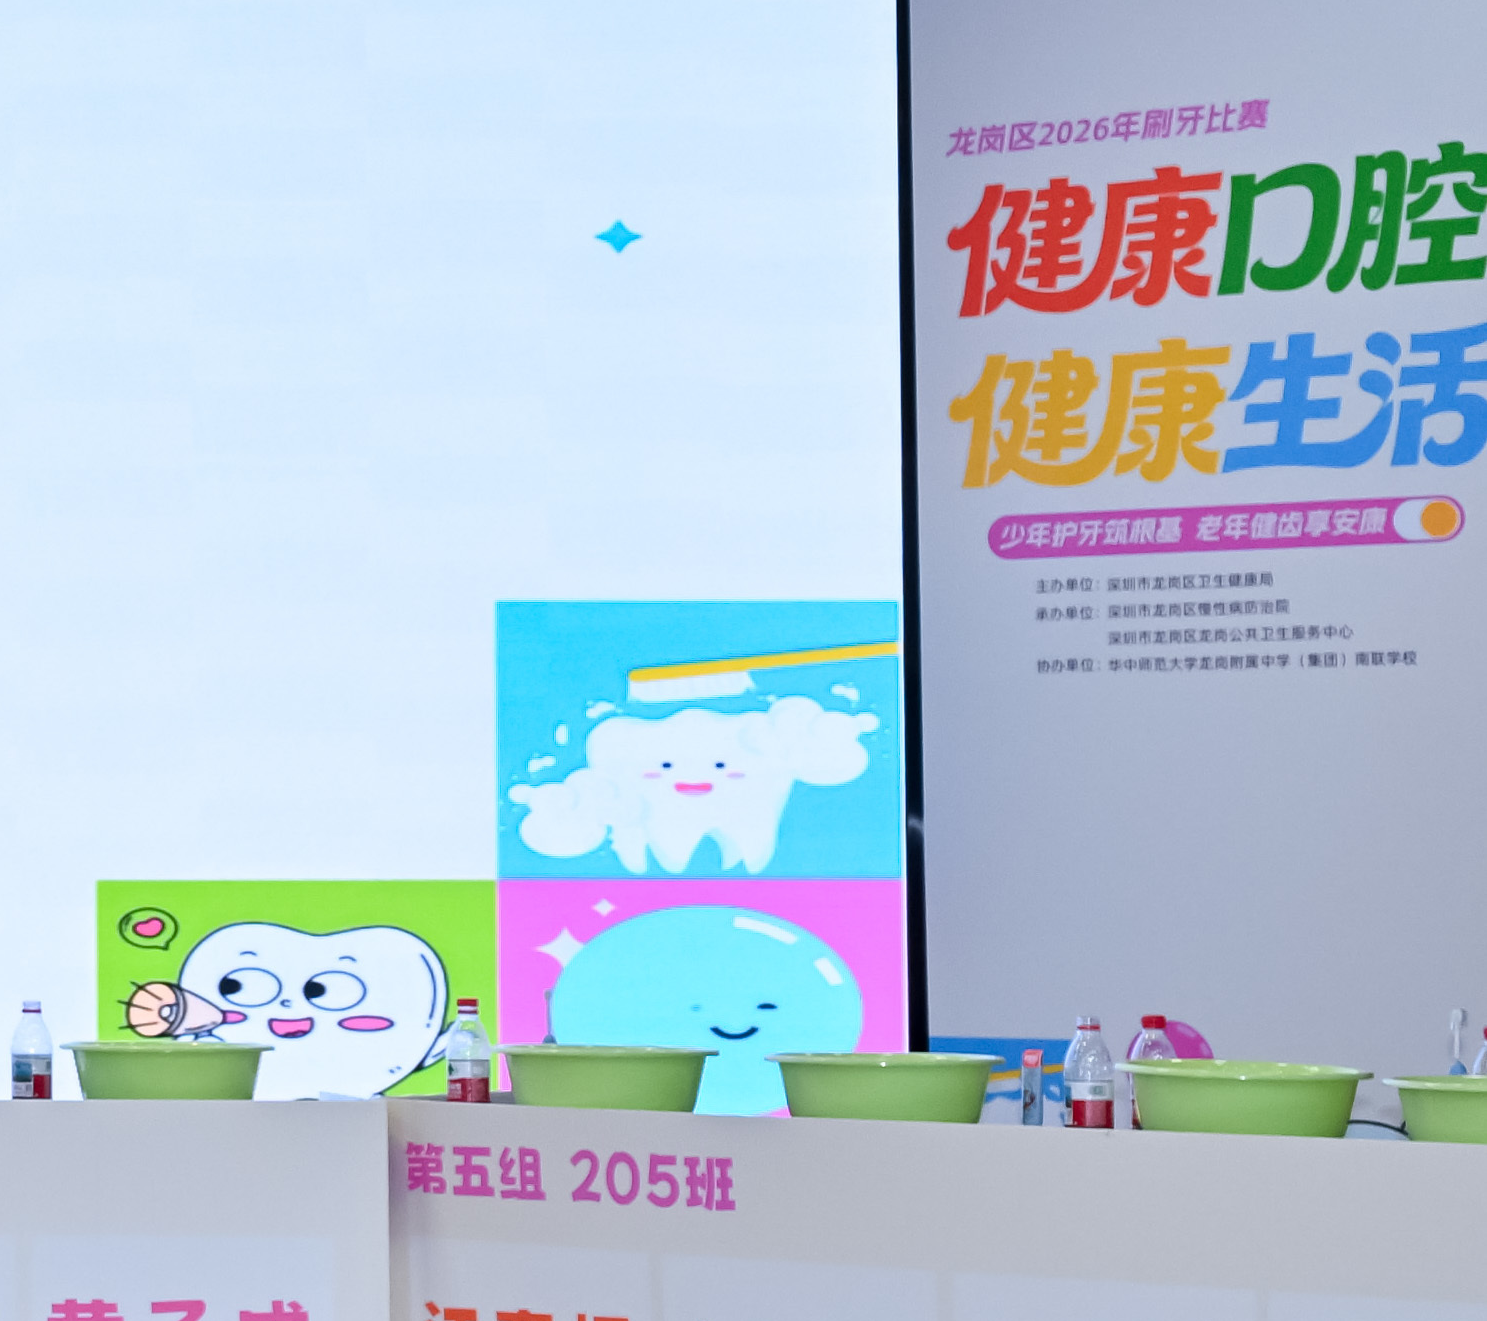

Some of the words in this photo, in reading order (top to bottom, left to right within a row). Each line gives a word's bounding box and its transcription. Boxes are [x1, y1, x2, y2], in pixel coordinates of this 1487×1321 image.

[946, 99, 1270, 158] 龙岗区2026年刷牙比赛
[946, 141, 1487, 318] 健康口腔
[948, 323, 1487, 489] 健康生活
[999, 516, 1183, 550] 少年护牙筑根基
[1196, 506, 1388, 542] 老年健齿享安康
[406, 1142, 547, 1201] 第五组
[570, 1149, 737, 1211] 205班
